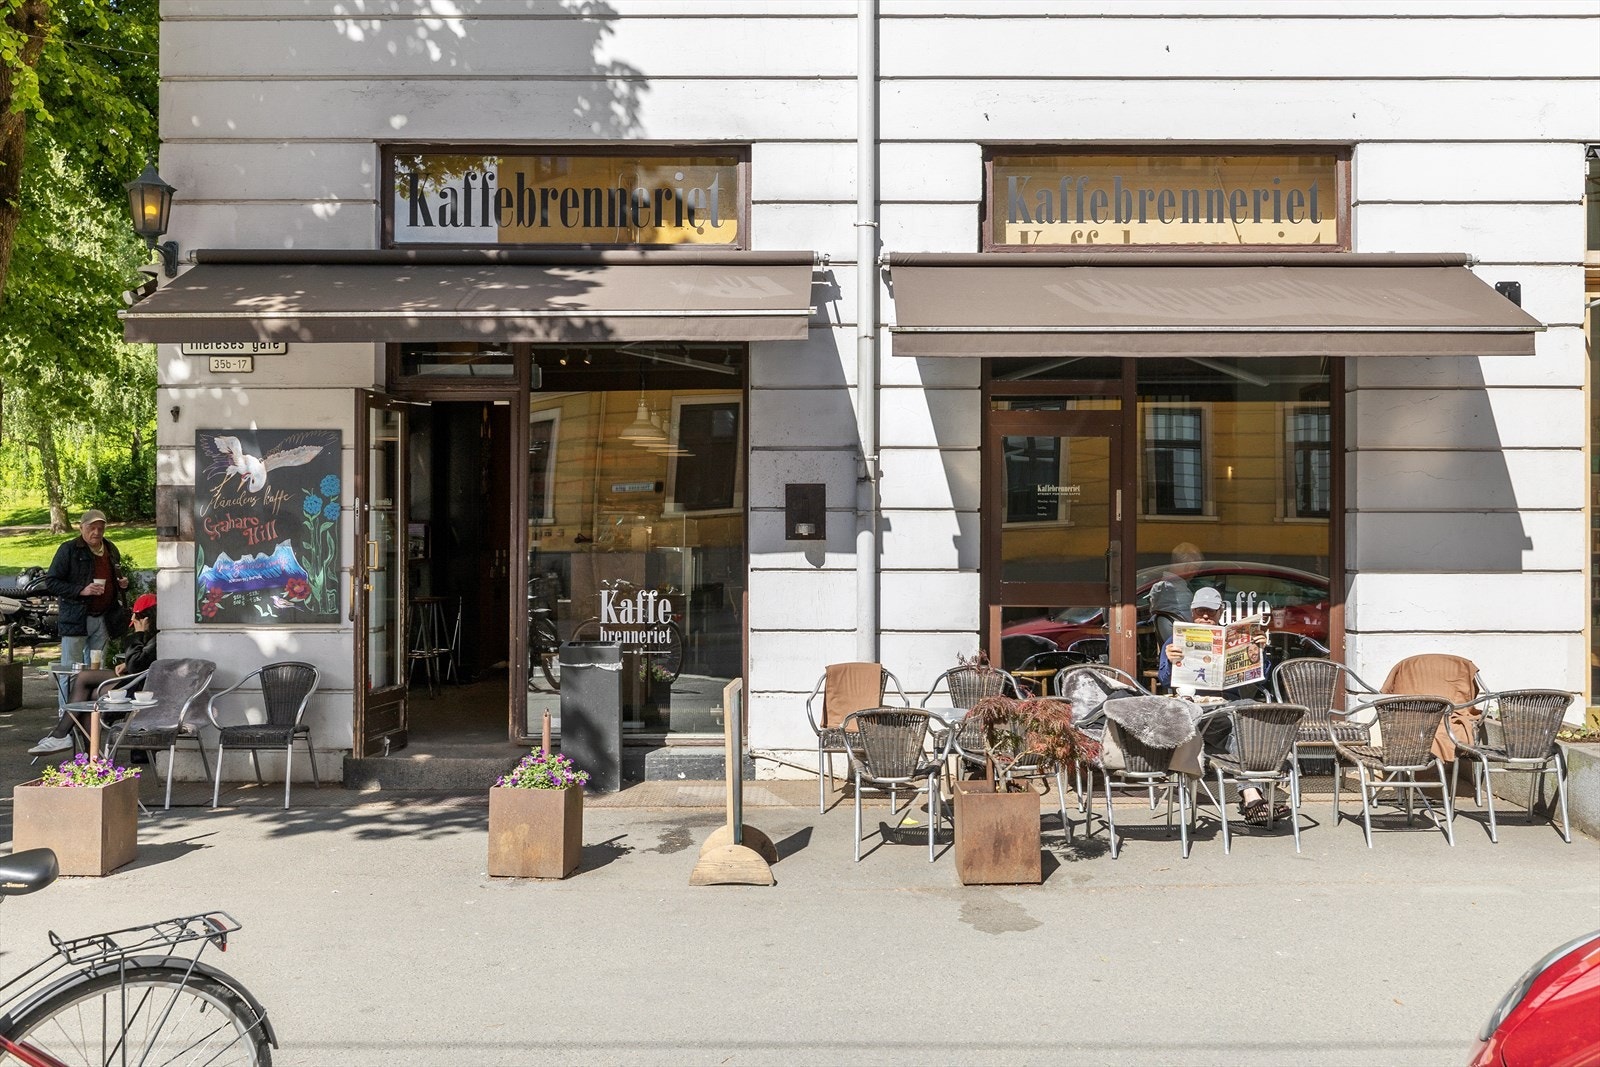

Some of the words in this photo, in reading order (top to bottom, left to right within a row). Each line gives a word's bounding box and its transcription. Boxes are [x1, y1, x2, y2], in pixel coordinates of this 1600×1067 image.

[406, 172, 725, 228] Kaffebrenneriet
[1006, 175, 1323, 225] Kaffebrenneriet
[1037, 484, 1081, 492] Kaffebrenneriet
[243, 519, 279, 545] Hill
[600, 589, 672, 625] Kaffe
[1218, 590, 1271, 626] affe
[600, 626, 672, 644] brenneriet
